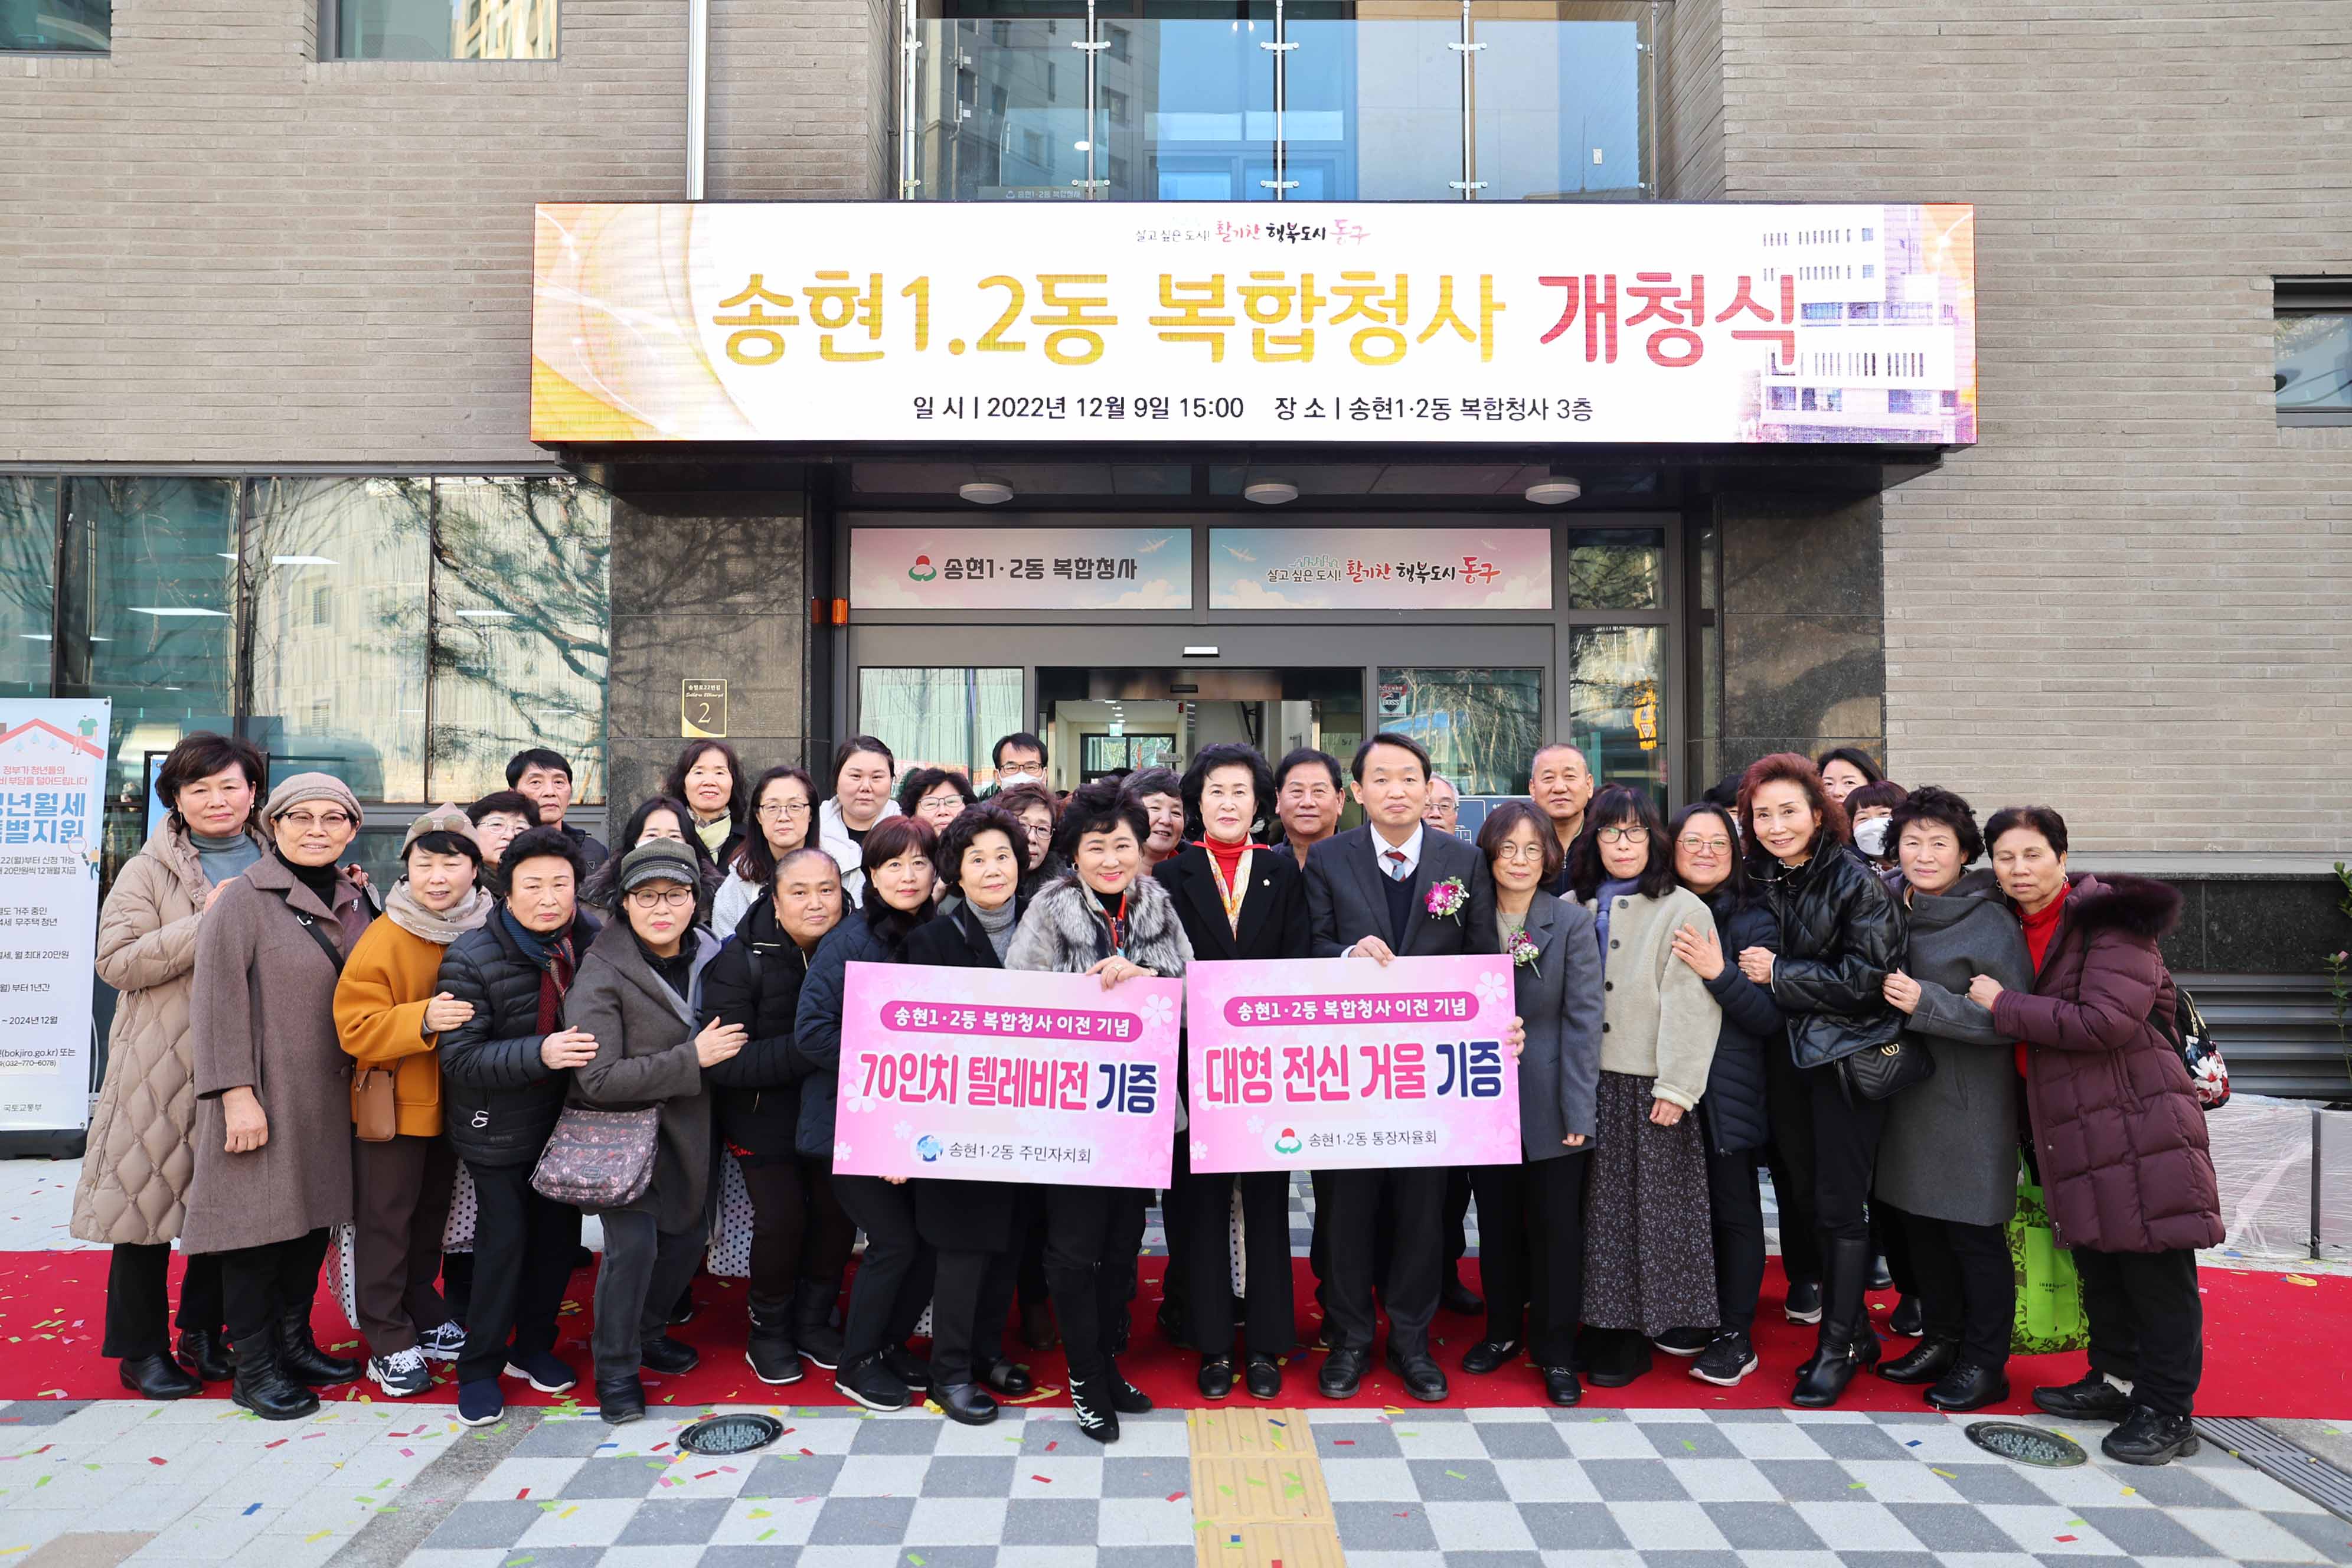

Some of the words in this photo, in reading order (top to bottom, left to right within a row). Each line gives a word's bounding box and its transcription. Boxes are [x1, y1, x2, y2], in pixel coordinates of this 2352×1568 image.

[1215, 220, 1261, 243] 활기찬
[1265, 221, 1327, 244] 행복도시
[1329, 219, 1371, 245] 동구
[1148, 270, 1507, 365] 복합청사
[1538, 270, 1795, 367] 개청식
[987, 396, 1065, 419] 2022년
[1076, 396, 1125, 420] 12월
[1134, 396, 1169, 420] 9일
[1180, 397, 1244, 418] 15:00
[1460, 397, 1549, 422] 복합청사
[1557, 397, 1593, 422] 3층
[1053, 557, 1138, 580] 복합청사
[1267, 569, 1289, 582] 살고
[1291, 569, 1314, 582] 싶은
[1316, 569, 1341, 582] 도시!
[1345, 560, 1391, 583] 활기찬
[1396, 561, 1456, 584] 행복도시
[1458, 557, 1501, 584] 동구
[698, 702, 711, 723] 2
[3, 766, 29, 775] 정부가
[9, 776, 34, 786] 부담을
[37, 776, 88, 786] 덜어드립니다
[0, 819, 84, 844] 별지원
[42, 856, 58, 865] 신청
[60, 856, 76, 865] 가능
[4, 867, 37, 875] 20만원씩
[38, 867, 60, 875] 12개월
[61, 867, 76, 875] 지급
[14, 907, 29, 916] 거주
[31, 907, 48, 916] 중인
[15, 918, 40, 926] 무주택
[41, 918, 57, 926] 청년
[15, 951, 22, 959] 월
[24, 951, 41, 959] 최대
[42, 950, 70, 959] 20만원
[30, 984, 50, 992] 1년간
[1323, 998, 1391, 1020] 복합청사
[1395, 998, 1429, 1017] 이전
[1433, 997, 1466, 1017] 기념
[9, 1016, 39, 1025] 2024년
[41, 1016, 58, 1025] 12월
[982, 1011, 1053, 1033] 복합청사
[1057, 1014, 1091, 1035] 이전
[1097, 1017, 1130, 1037] 기념
[60, 1048, 76, 1057] 또는
[1206, 1045, 1273, 1105] 대형
[1282, 1044, 1350, 1102] 전신
[1360, 1043, 1426, 1100] 거울
[1436, 1041, 1502, 1098] 기증
[860, 1052, 959, 1105] 70인치
[968, 1056, 1089, 1111] 텔레비전
[1096, 1062, 1157, 1114] 기증
[4, 1103, 43, 1112] 국토교통부
[1371, 1129, 1438, 1146] 통장자율회
[1018, 1144, 1092, 1164] 주민자치회
